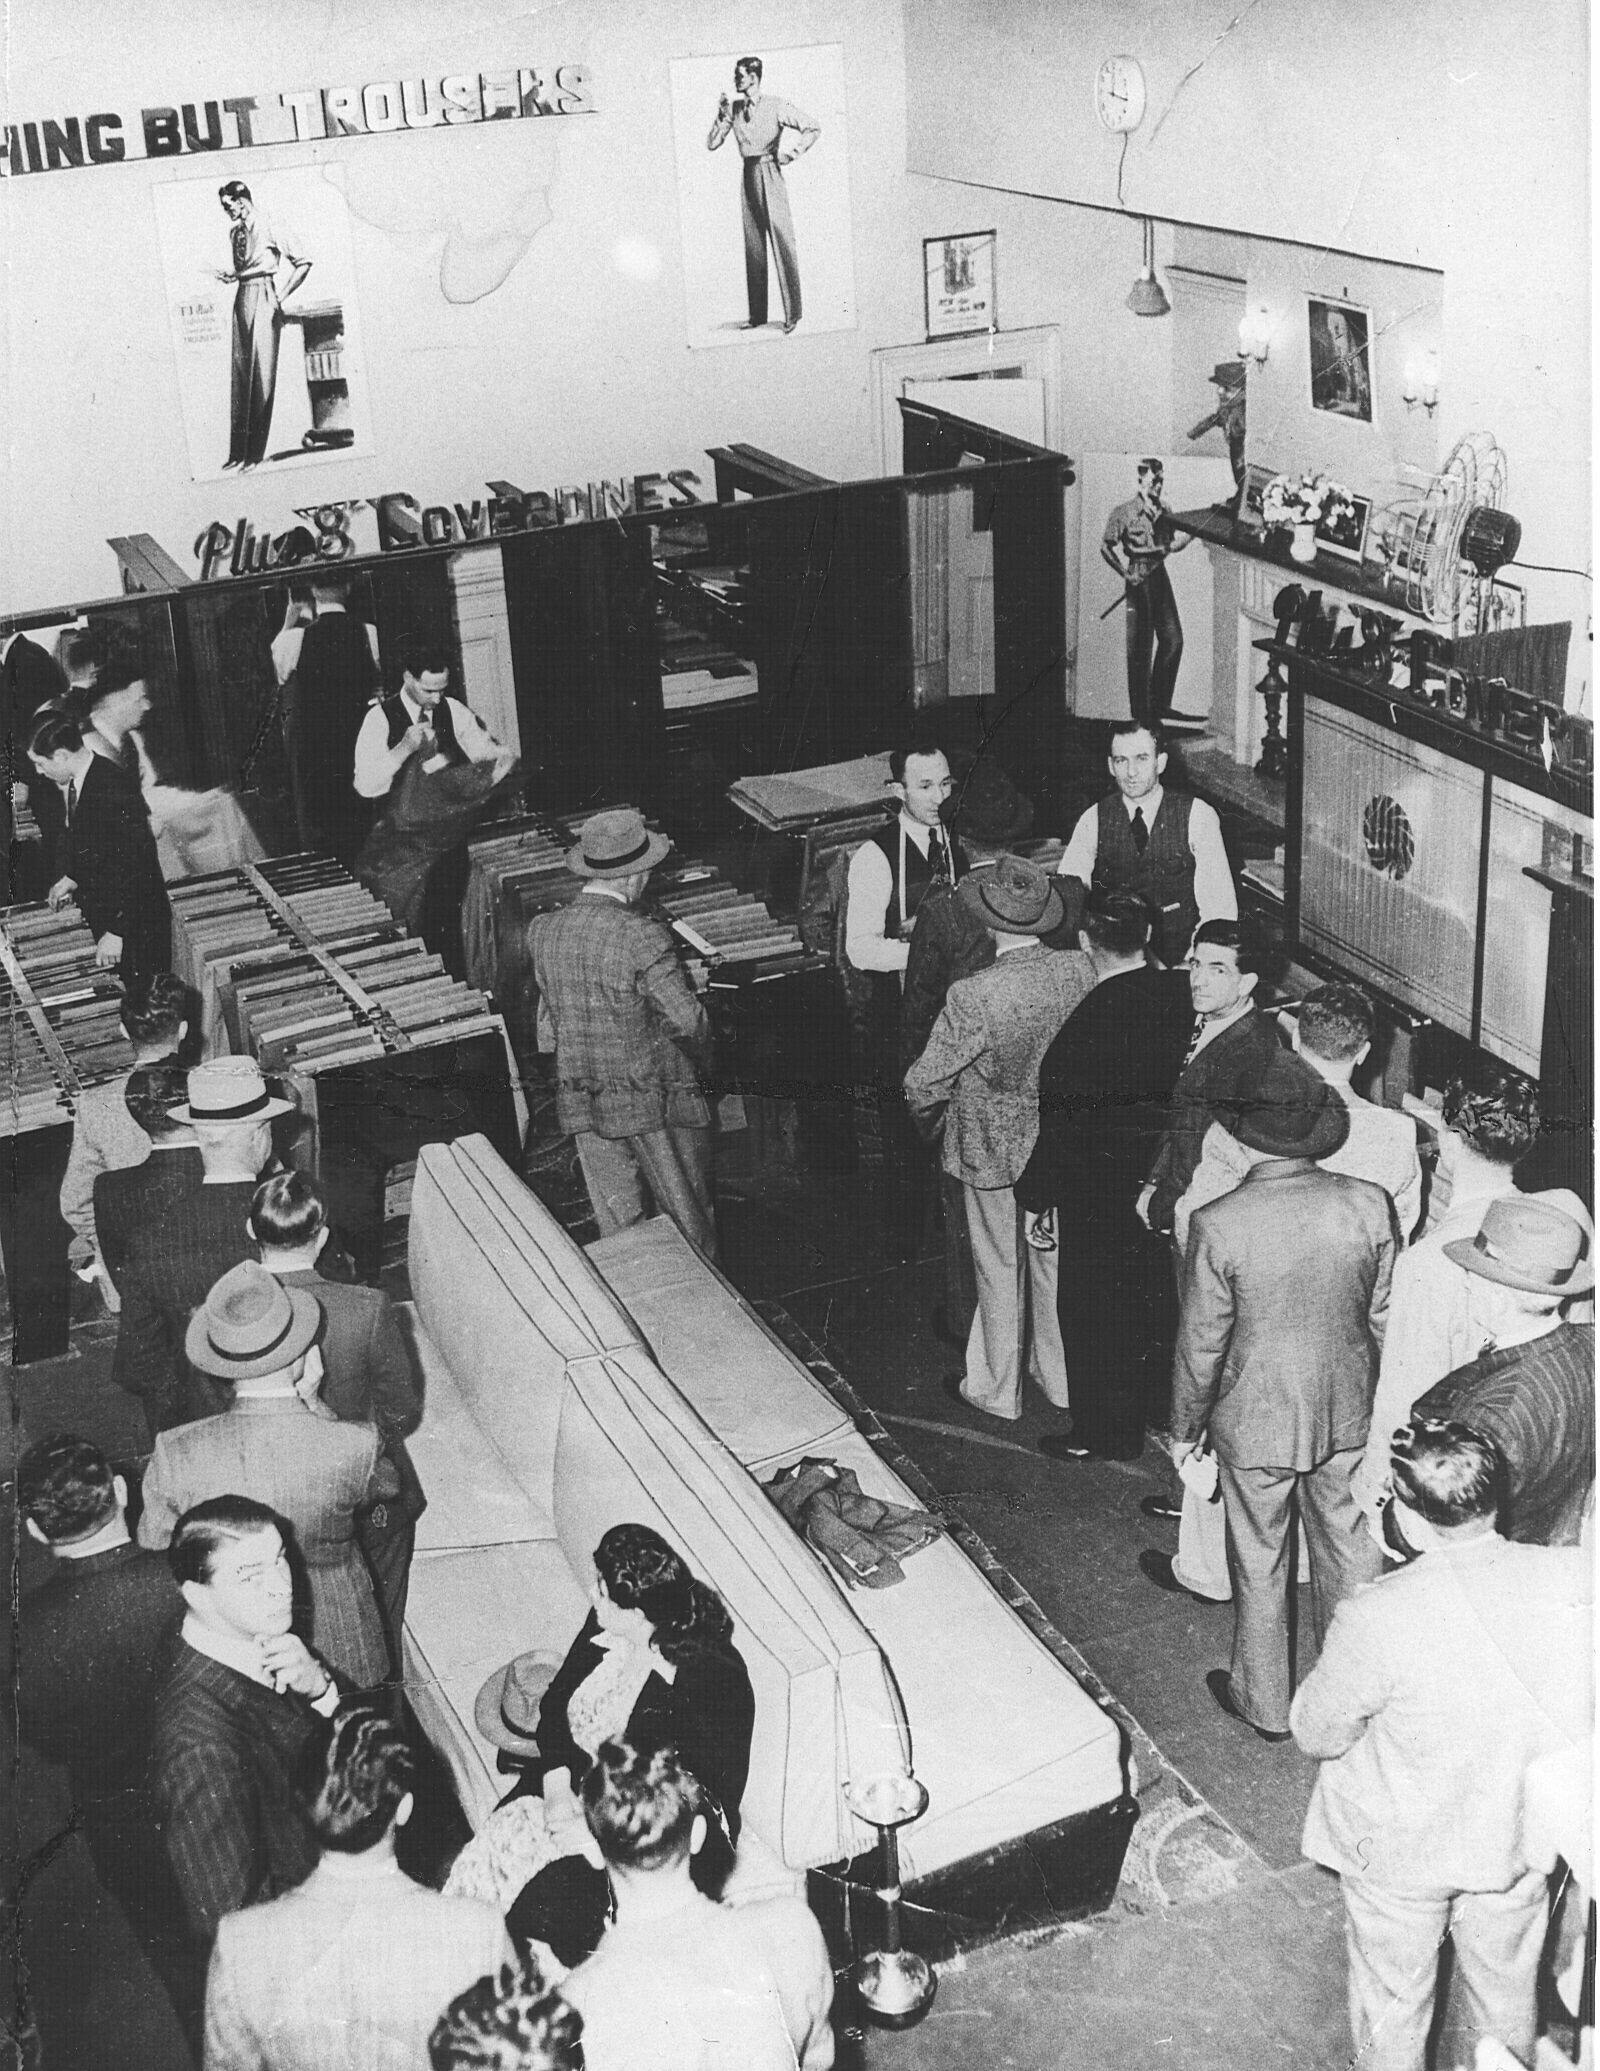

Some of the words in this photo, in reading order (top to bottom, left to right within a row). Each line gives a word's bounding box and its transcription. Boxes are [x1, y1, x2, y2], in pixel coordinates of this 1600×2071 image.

[141, 94, 257, 158] BUT
[279, 64, 597, 142] TROUSERS
[313, 505, 354, 560] 8
